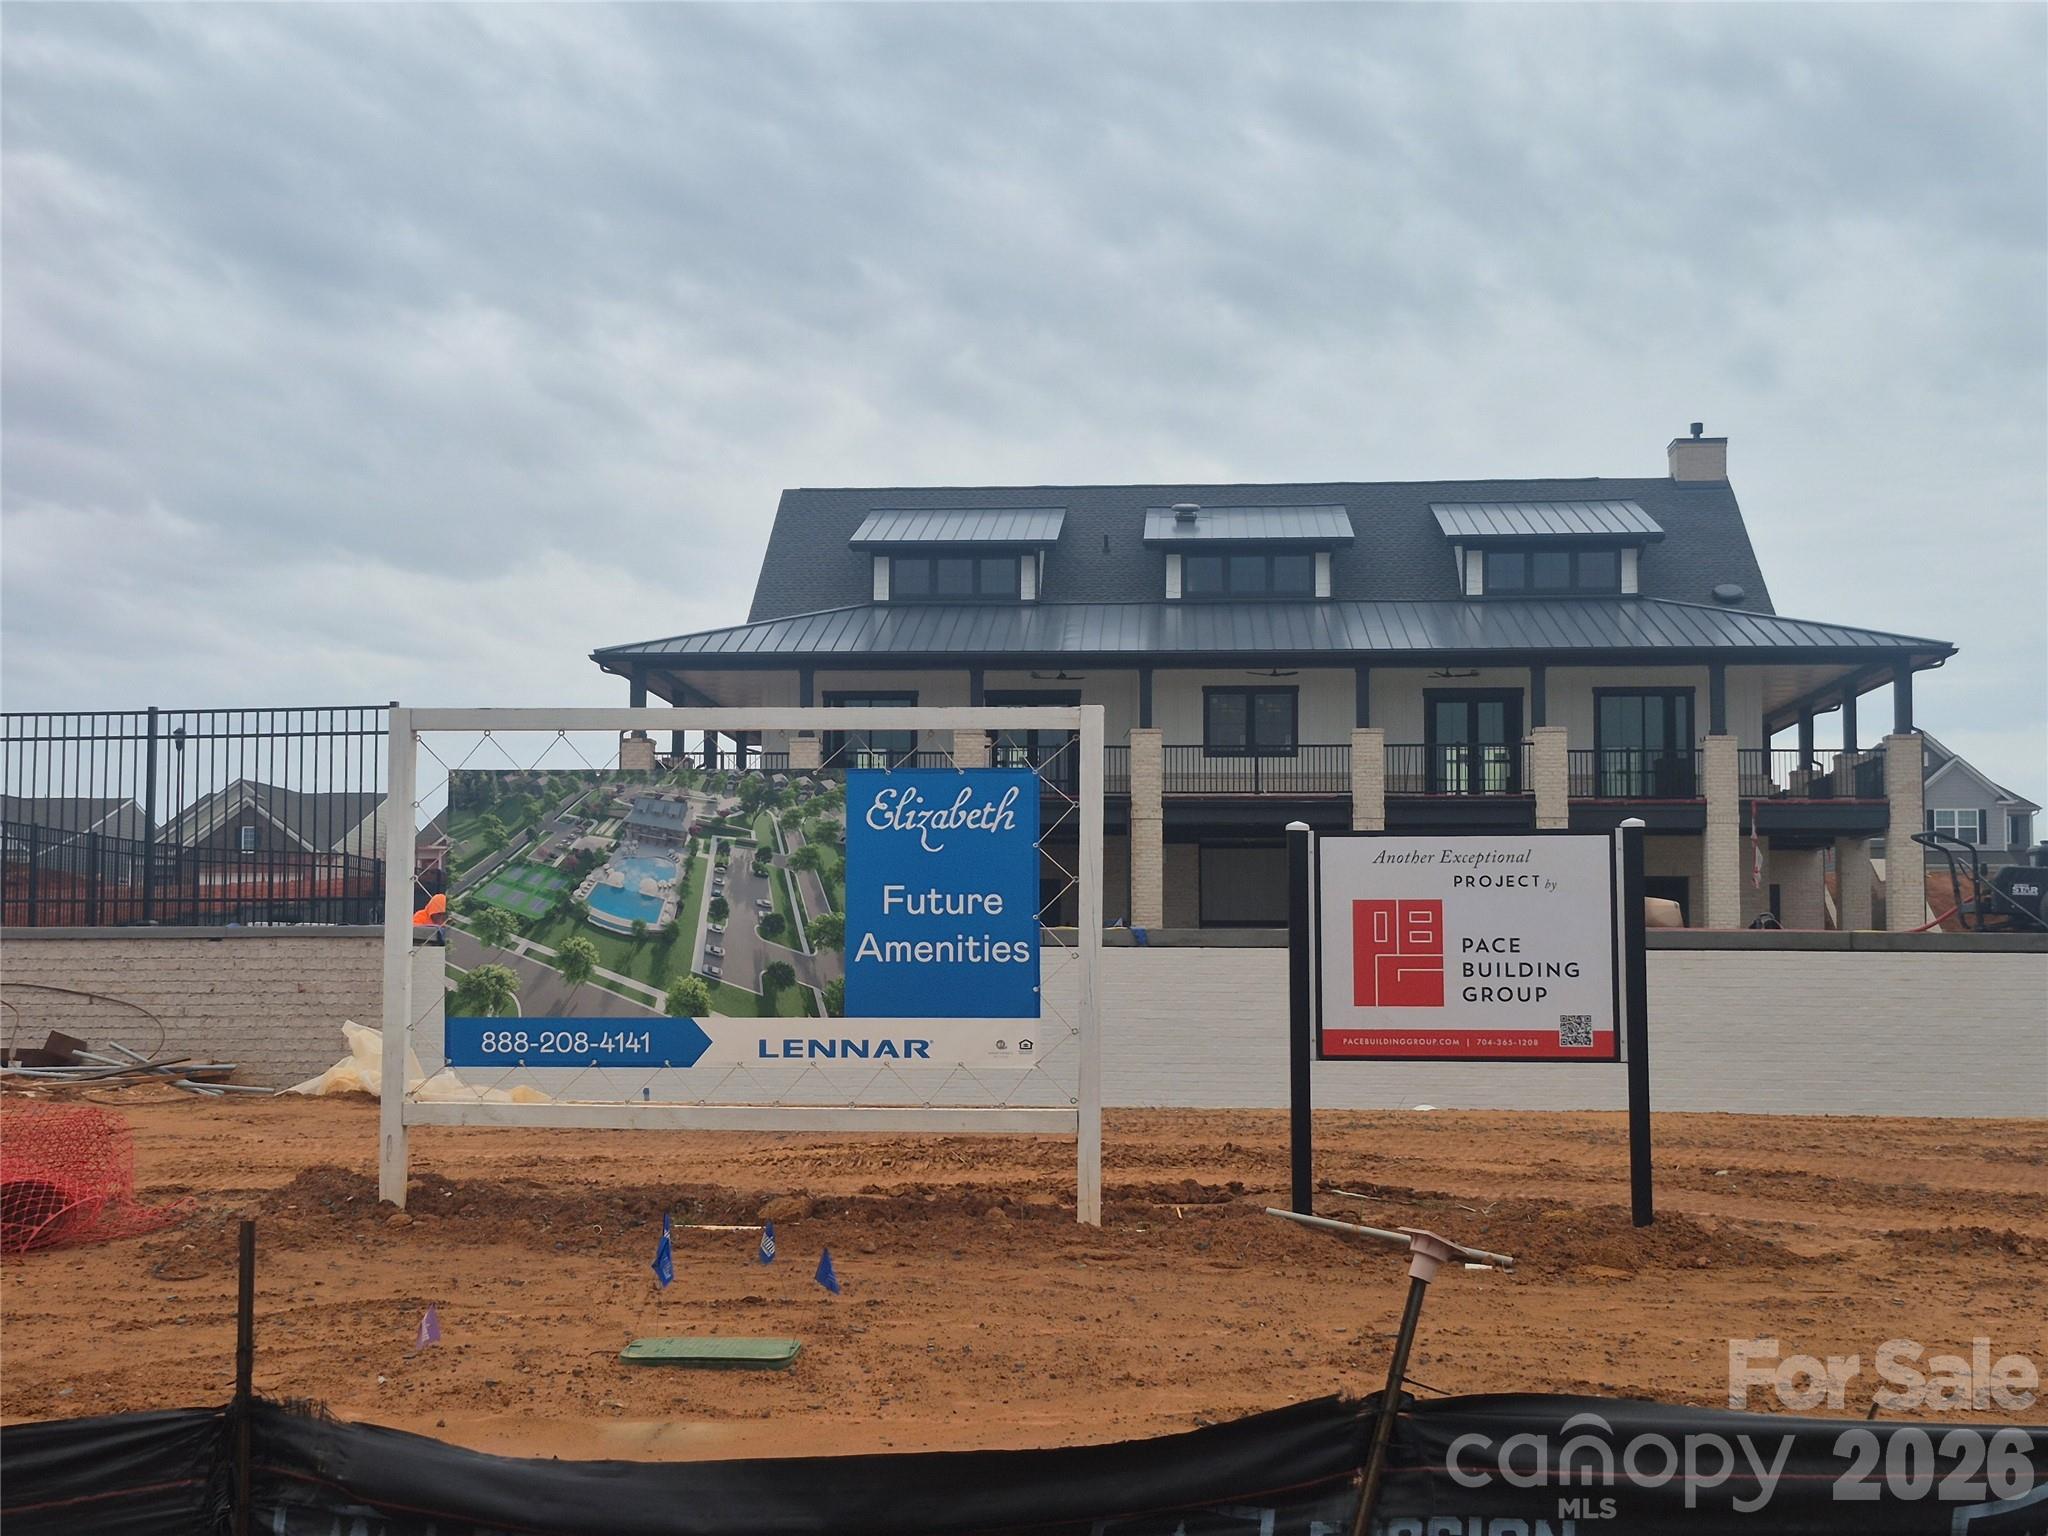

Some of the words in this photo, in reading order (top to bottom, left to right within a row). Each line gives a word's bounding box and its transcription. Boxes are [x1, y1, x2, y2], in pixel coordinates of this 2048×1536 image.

[866, 786, 1020, 852] Elizabeth
[1372, 849, 1435, 864] Another
[1439, 849, 1532, 869] Exceptional
[1453, 875, 1540, 888] PROJECT
[1544, 878, 1557, 892] by
[883, 885, 1003, 915] Future
[854, 932, 1030, 962] Amenities
[1462, 937, 1521, 953] PACE
[1462, 962, 1580, 978] BUILDING
[1462, 986, 1548, 1003] GROUP
[481, 1031, 650, 1054] 888-208-4141
[758, 1039, 931, 1059] LENNAR
[1342, 1037, 1460, 1047] PACEBUILDINGGROUP.COM
[1476, 1037, 1539, 1047] 704-365-1208
